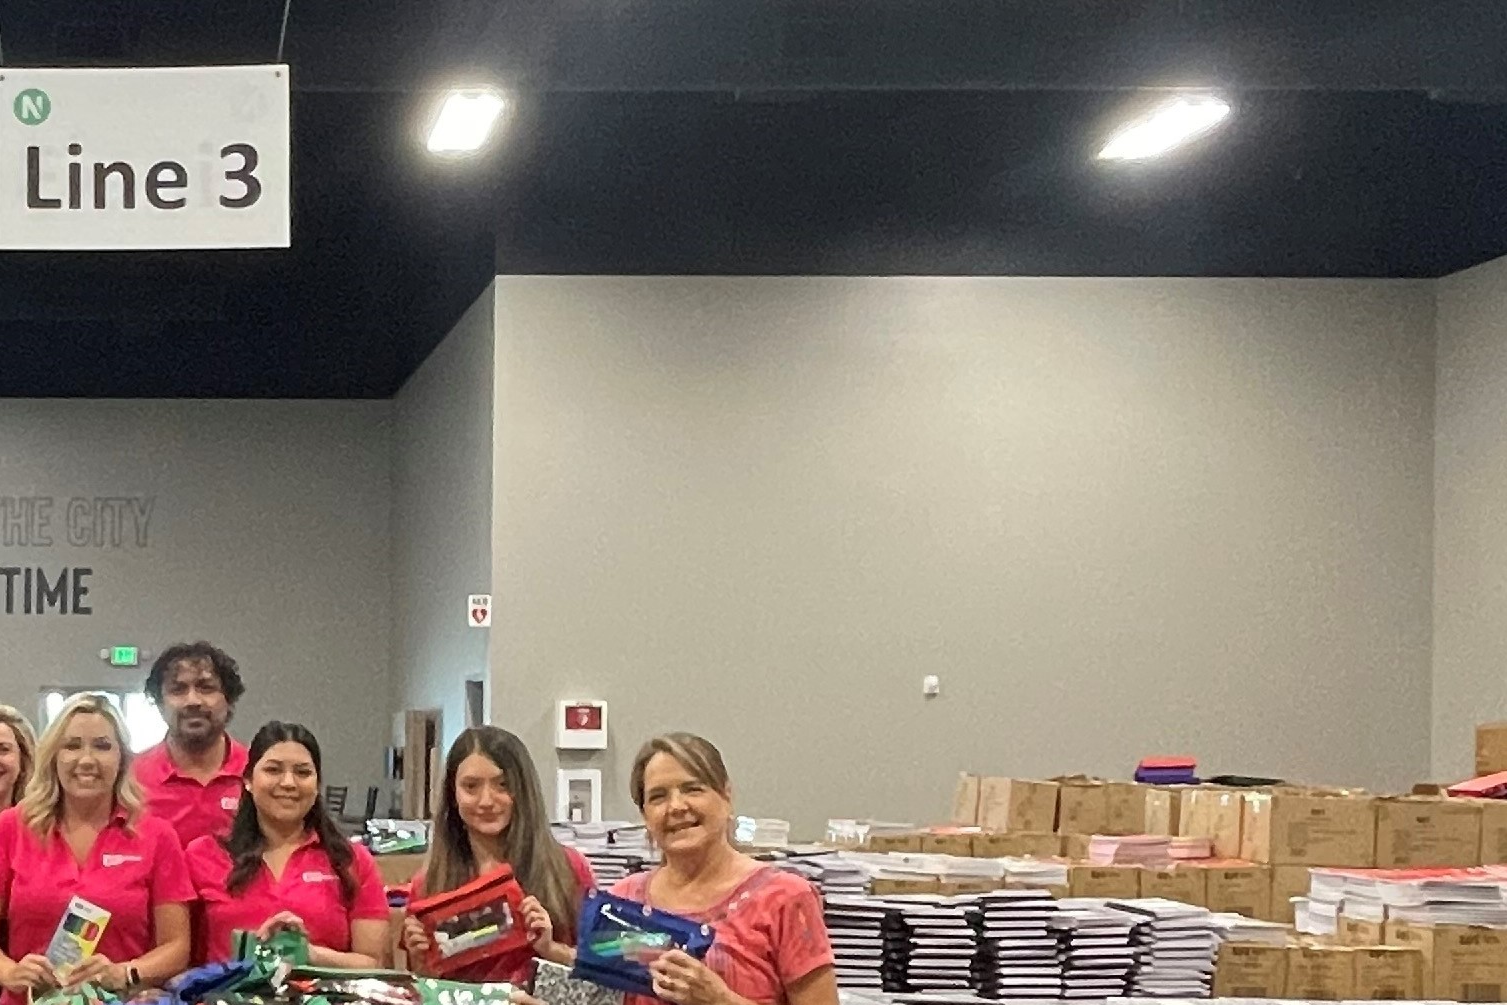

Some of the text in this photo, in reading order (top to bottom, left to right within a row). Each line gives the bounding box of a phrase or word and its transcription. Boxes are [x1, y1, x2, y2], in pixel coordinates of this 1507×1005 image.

[26, 142, 262, 210] Line 3
[65, 496, 156, 548] CITY
